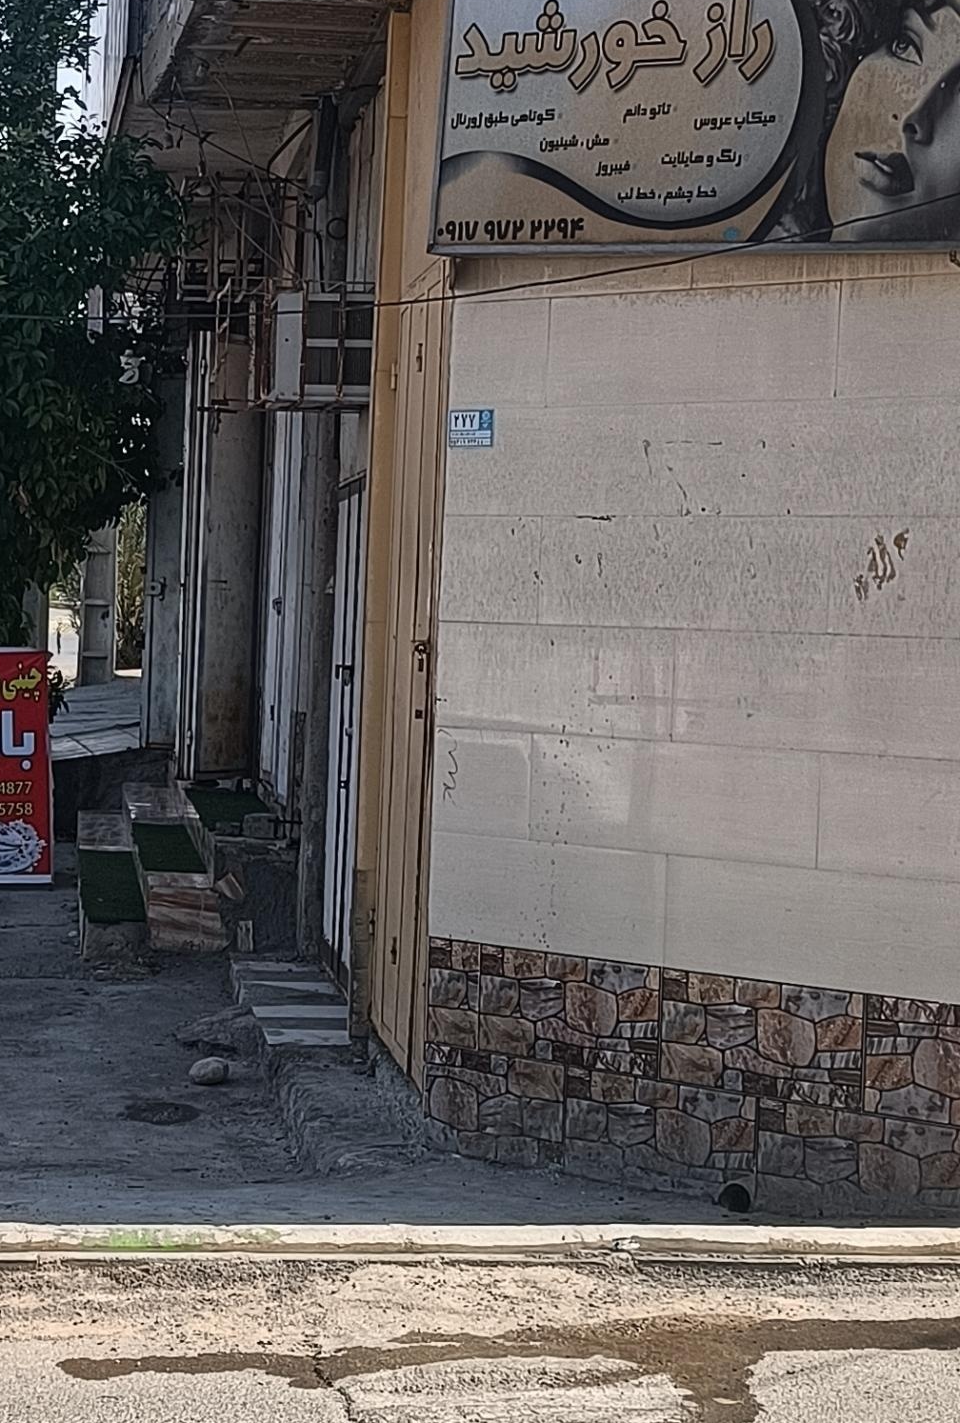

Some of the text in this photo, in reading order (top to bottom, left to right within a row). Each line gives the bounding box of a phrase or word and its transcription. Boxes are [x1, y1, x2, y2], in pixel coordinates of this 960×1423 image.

[484, 110, 509, 128] طبق
[510, 108, 556, 127] کوتاهی
[649, 102, 672, 120] تاتو
[693, 111, 776, 131] میکاپ عروس
[661, 149, 742, 168] رنگ و هایلایت
[617, 187, 634, 201] لب
[635, 186, 656, 199] خط
[696, 185, 717, 199] خط
[437, 217, 585, 241] ۰۹۱۷ ۹۷۲ ۲۲۹۴
[3, 663, 42, 701] چینی
